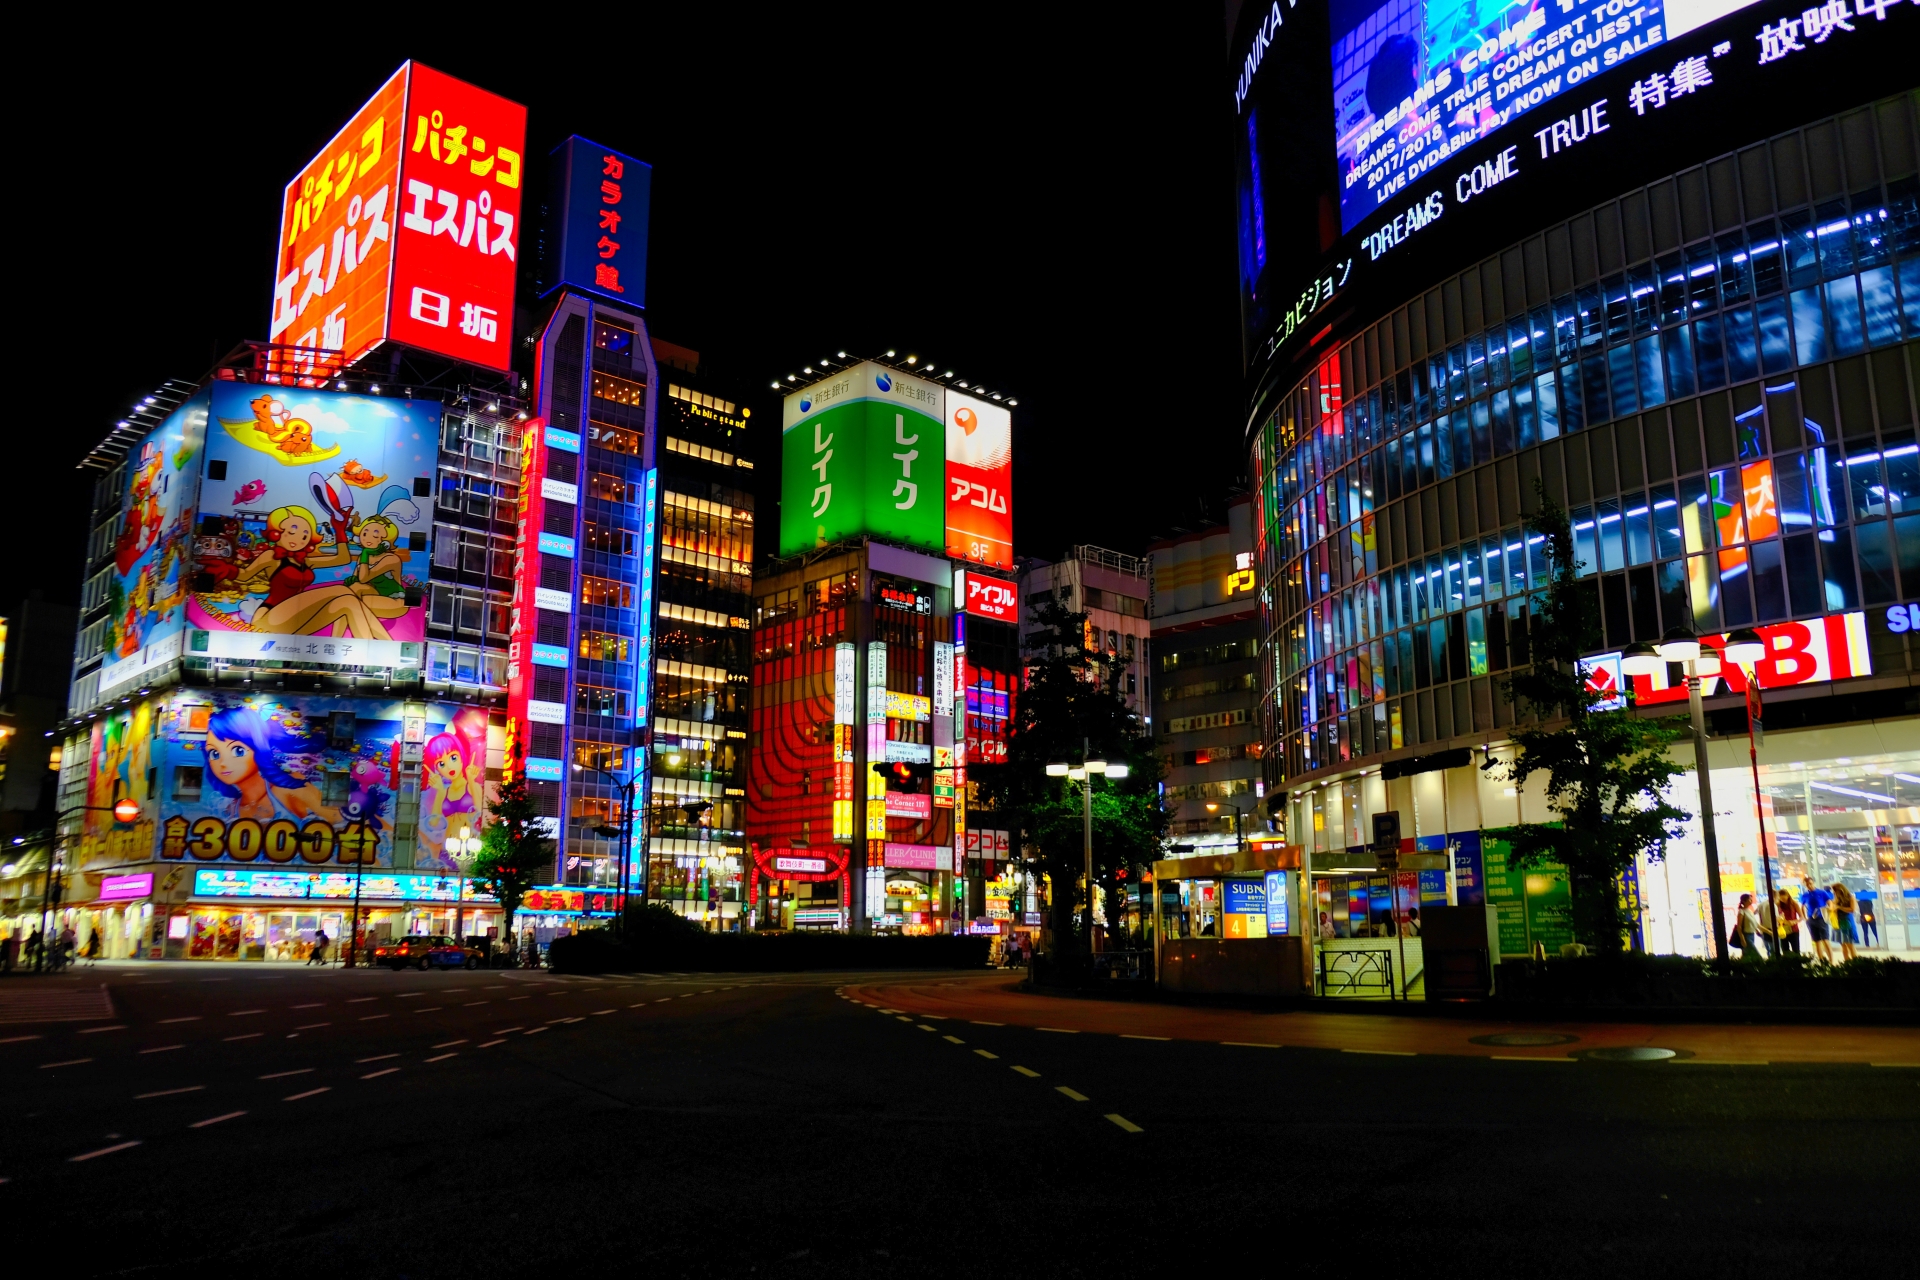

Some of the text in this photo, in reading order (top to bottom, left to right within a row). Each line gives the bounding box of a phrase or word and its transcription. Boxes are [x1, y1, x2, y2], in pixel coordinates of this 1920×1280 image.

[1236, 2, 1283, 114] YUNIKA
[1356, 7, 1546, 155] DREAMS COME
[1345, 138, 1396, 189] DREAMS
[1398, 105, 1441, 142] COME
[1443, 72, 1490, 111] TRUE
[1493, 15, 1587, 81] CONCERT
[1368, 124, 1443, 189] 2017/2018
[1496, 49, 1565, 101] DREAM
[1377, 24, 1663, 203] LIVE DVD&Blu-ray NOW ON SALE
[412, 110, 520, 189] パチンコ
[1456, 145, 1520, 203] COME
[1534, 99, 1610, 159] TRUE
[288, 115, 384, 246] パチンコ
[403, 178, 514, 262] エスパス
[271, 184, 389, 339] エスパス
[410, 286, 498, 343] 日拓
[1267, 258, 1351, 360] ユニカビジョン
[691, 404, 717, 420] Public
[814, 380, 850, 405] 新生銀行
[895, 381, 937, 406] 新生銀行
[519, 430, 534, 513] パチンコ
[811, 423, 834, 518] レイク
[893, 413, 919, 510] レイク
[951, 477, 1007, 514] アコム
[510, 519, 527, 636] エスパス
[971, 542, 989, 558] 3F
[968, 580, 1016, 607] アイフル
[1227, 570, 1254, 596] ドン
[306, 643, 352, 656] 北電子
[845, 657, 853, 713] 小松ビル
[969, 690, 1005, 706] PROMSE
[894, 799, 914, 807] Corner
[1375, 815, 1397, 847] P
[190, 817, 380, 864] 3000台
[968, 834, 1009, 851] アコム
[1879, 851, 1915, 860] ANING
[1269, 879, 1278, 902] P
[1231, 919, 1241, 935] 4
